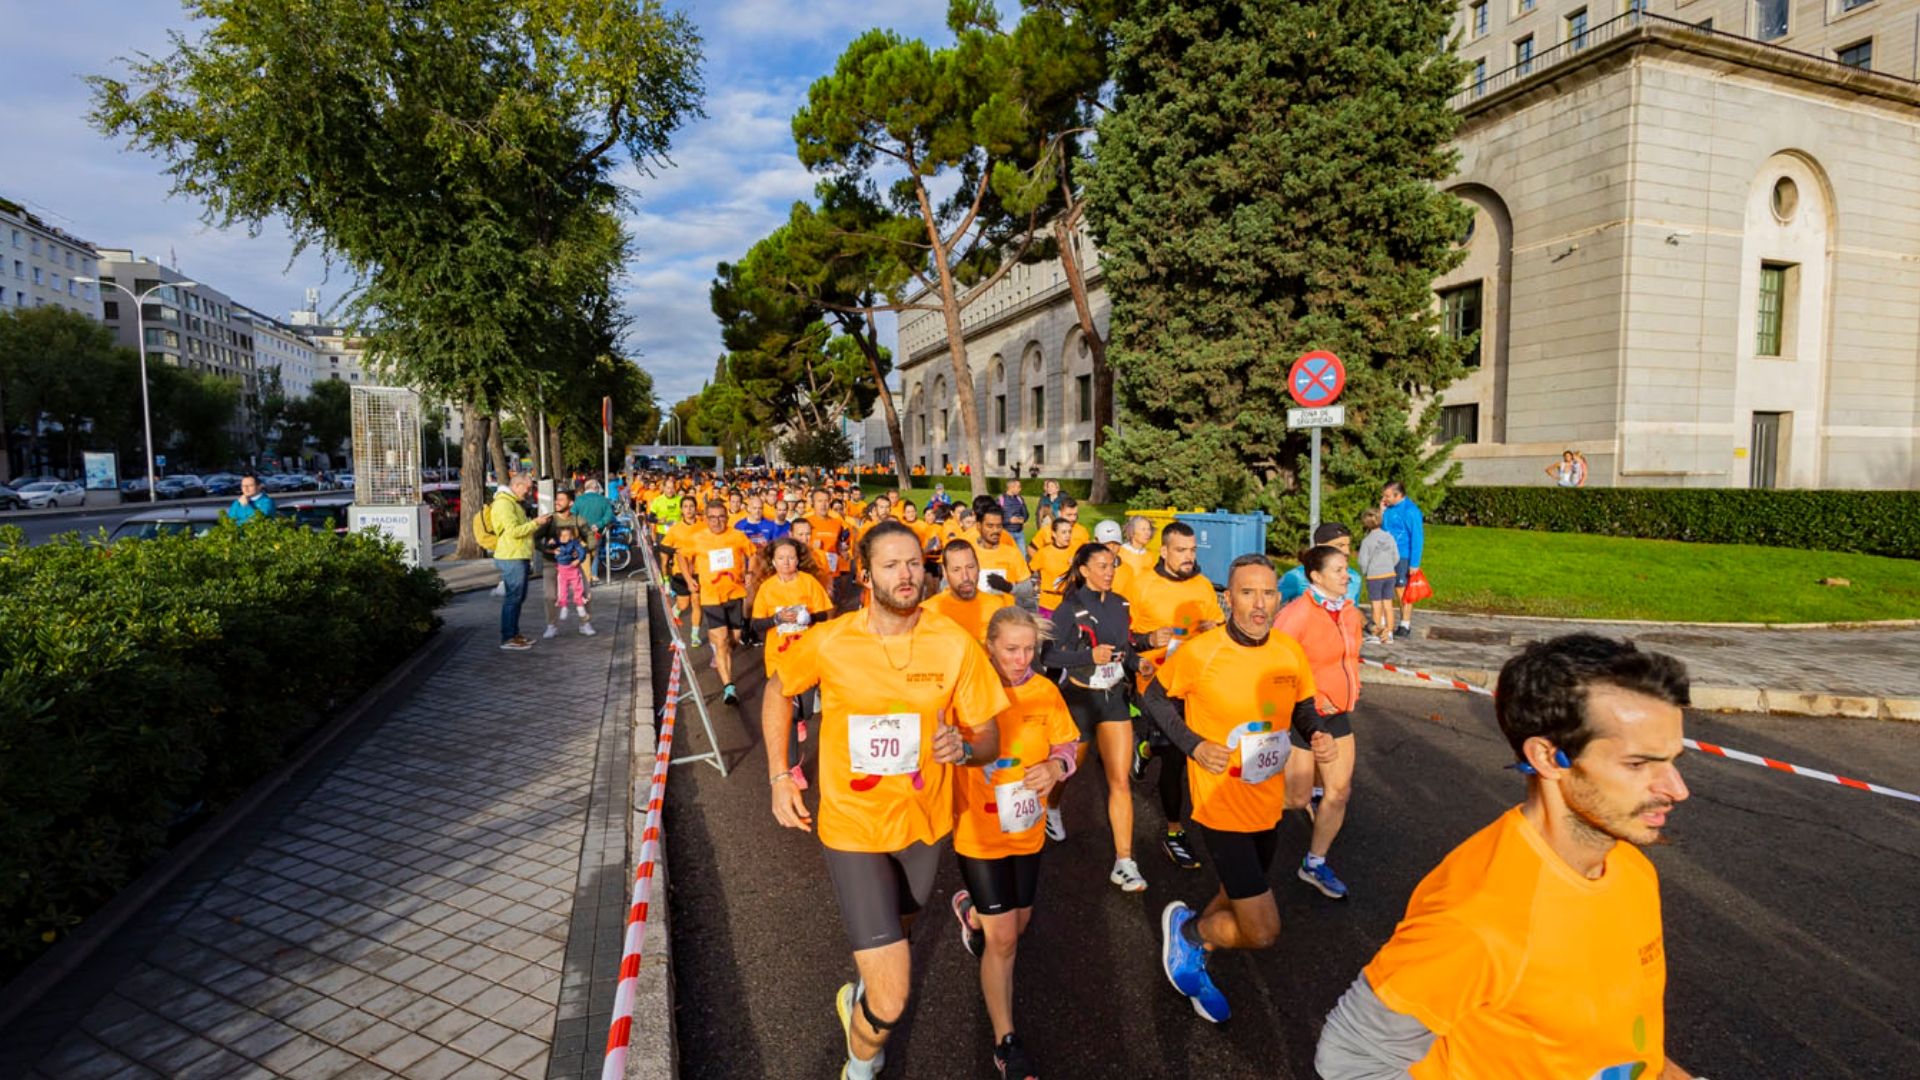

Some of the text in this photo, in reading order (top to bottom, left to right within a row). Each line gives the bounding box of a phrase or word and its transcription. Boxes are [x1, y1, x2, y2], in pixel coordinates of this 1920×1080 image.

[371, 516, 409, 524] MADRID
[870, 738, 900, 758] 570
[1257, 750, 1280, 769] 365
[1013, 798, 1036, 818] 248
